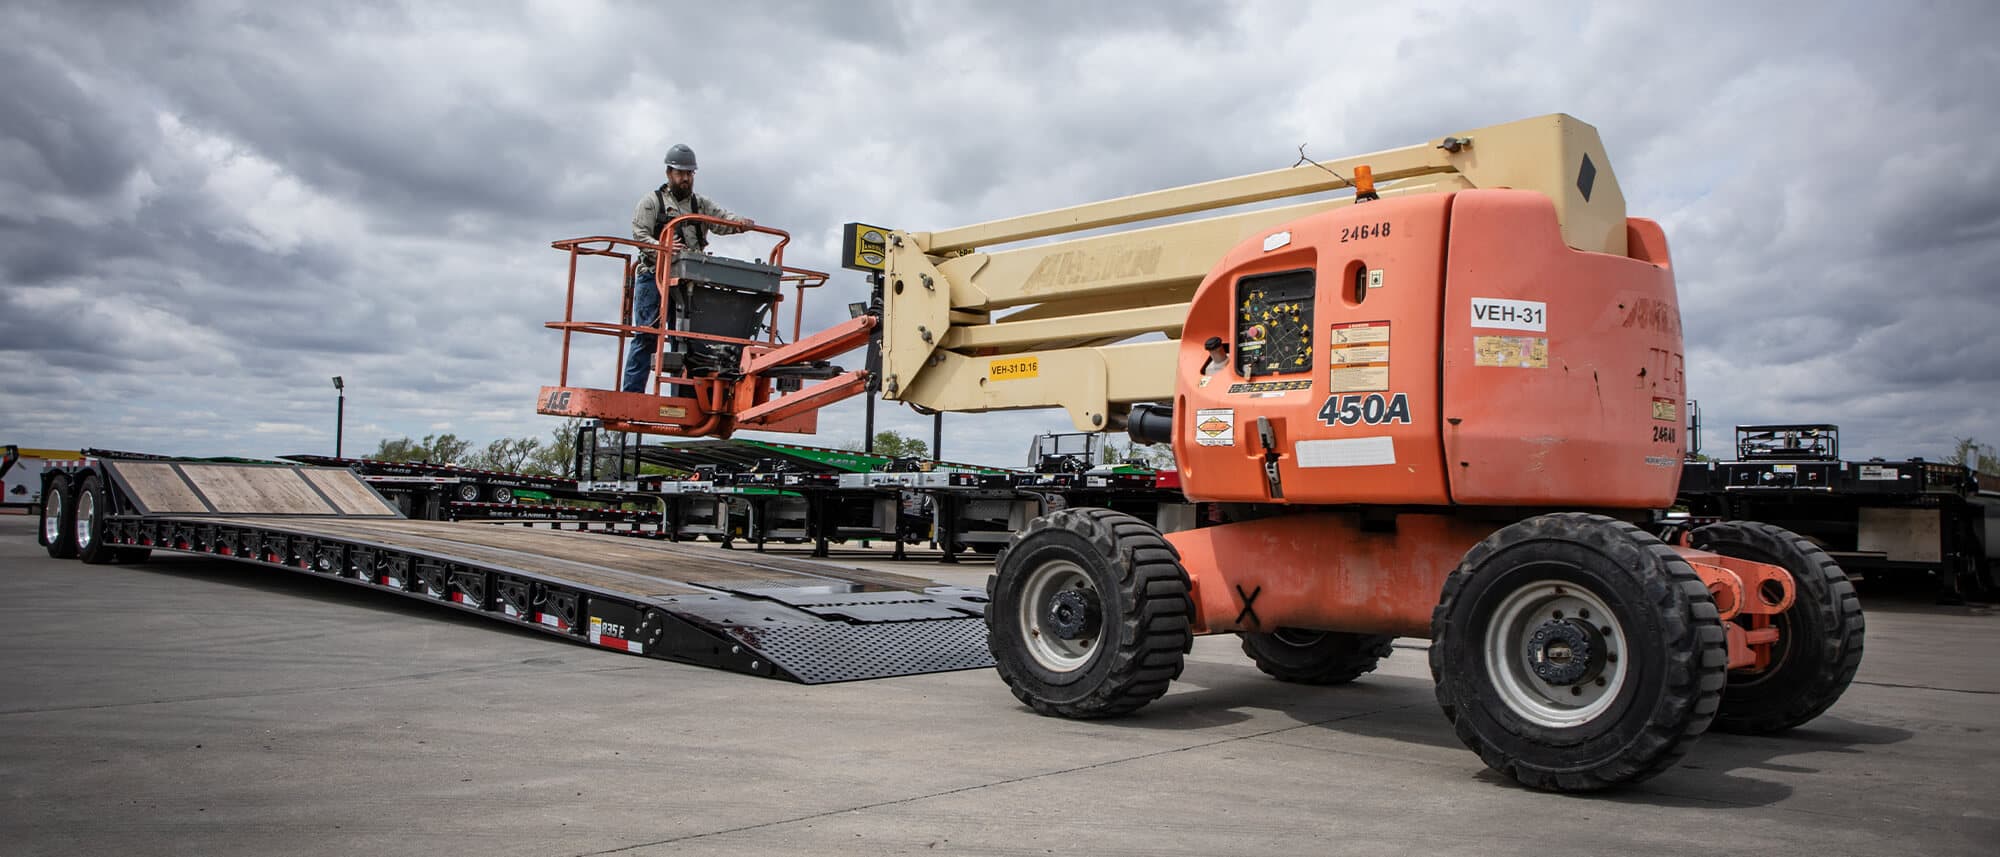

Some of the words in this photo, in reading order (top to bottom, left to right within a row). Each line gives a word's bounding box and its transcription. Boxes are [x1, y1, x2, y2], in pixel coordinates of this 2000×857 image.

[1340, 222, 1391, 243] 24648
[1473, 304, 1543, 325] VEH-31
[992, 363, 1018, 375] VEH-31
[1020, 361, 1037, 373] D.16
[545, 391, 572, 411] JLG
[1317, 392, 1412, 427] 450A
[602, 622, 619, 637] 835
[618, 625, 625, 639] E
